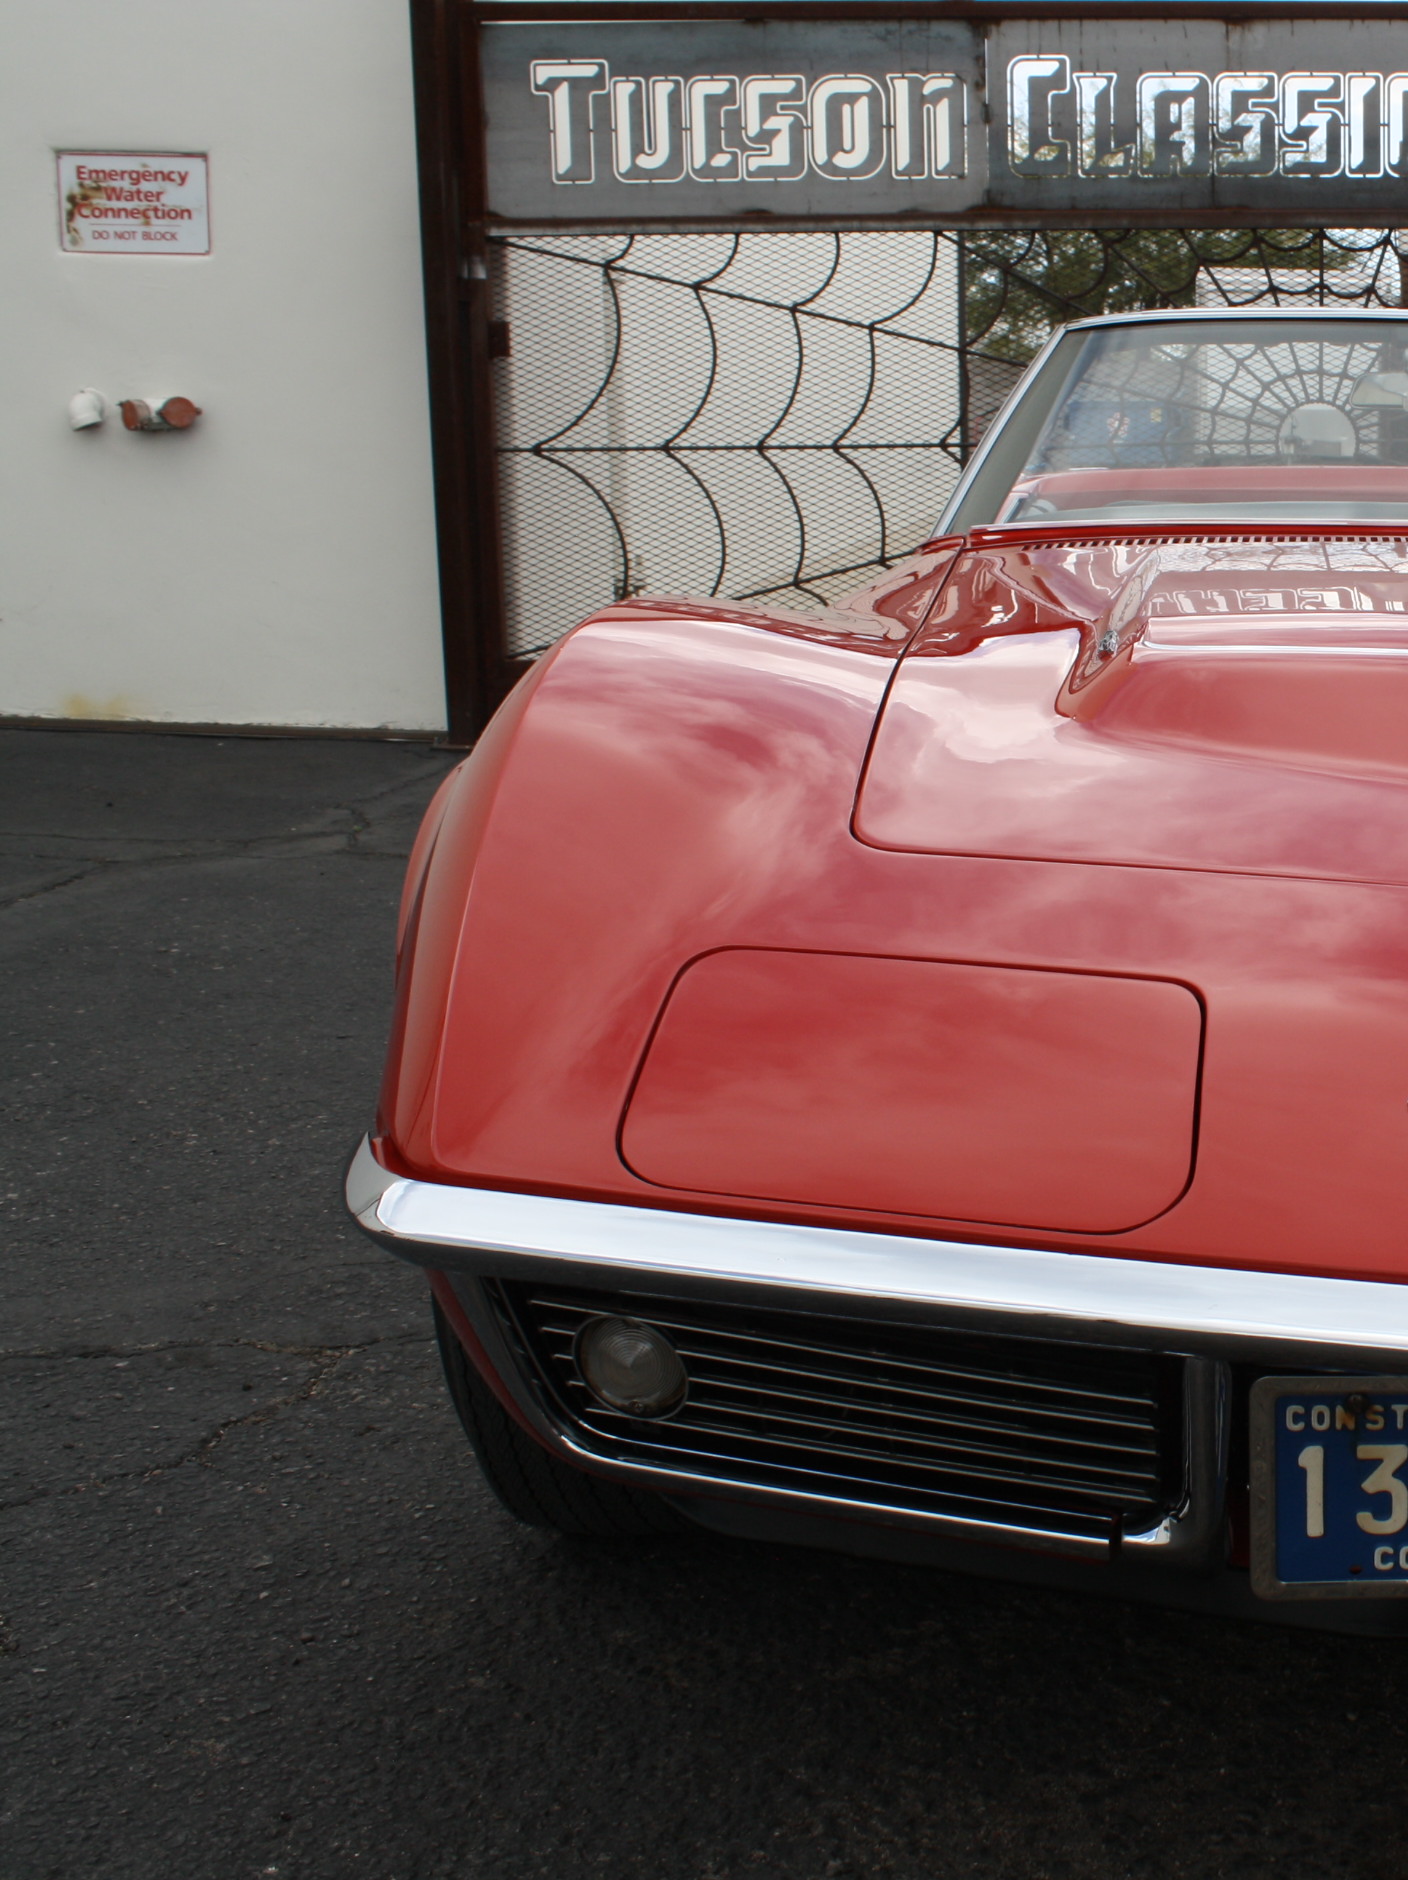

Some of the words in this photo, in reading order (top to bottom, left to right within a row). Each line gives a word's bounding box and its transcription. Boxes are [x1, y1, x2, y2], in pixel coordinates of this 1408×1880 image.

[75, 165, 189, 186] Emergency
[102, 186, 165, 202] Water
[76, 202, 193, 220] Connection
[92, 230, 110, 240] DO
[113, 231, 138, 240] NOT
[141, 231, 178, 241] BLOCK
